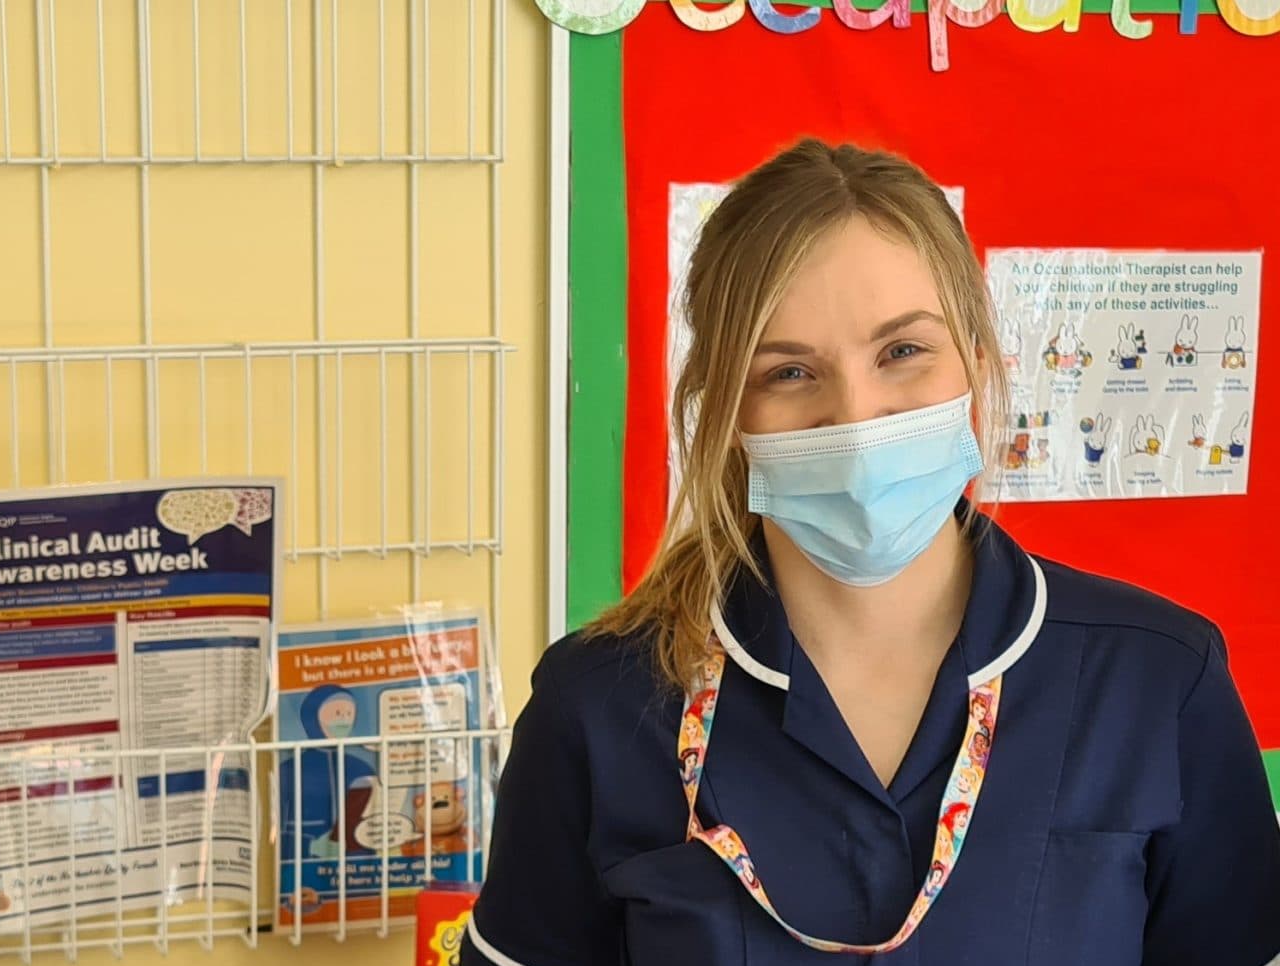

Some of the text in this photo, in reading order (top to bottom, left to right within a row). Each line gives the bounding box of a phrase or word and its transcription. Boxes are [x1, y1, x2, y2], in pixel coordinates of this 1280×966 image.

[1126, 262, 1187, 277] Therapist
[1190, 264, 1212, 276] can
[1216, 263, 1243, 277] help
[1049, 281, 1104, 293] children
[1108, 281, 1116, 293] if
[1120, 281, 1148, 295] they
[1151, 282, 1171, 293] are
[1174, 280, 1239, 295] struggling
[1068, 301, 1090, 313] any
[1096, 298, 1108, 310] of
[1111, 298, 1147, 310] these
[1150, 297, 1219, 311] activities...
[85, 525, 162, 554] Audit
[133, 546, 209, 576] Week
[294, 656, 300, 668] I
[303, 653, 343, 667] know
[354, 647, 385, 662] look
[302, 669, 324, 682] but
[327, 665, 362, 680] there
